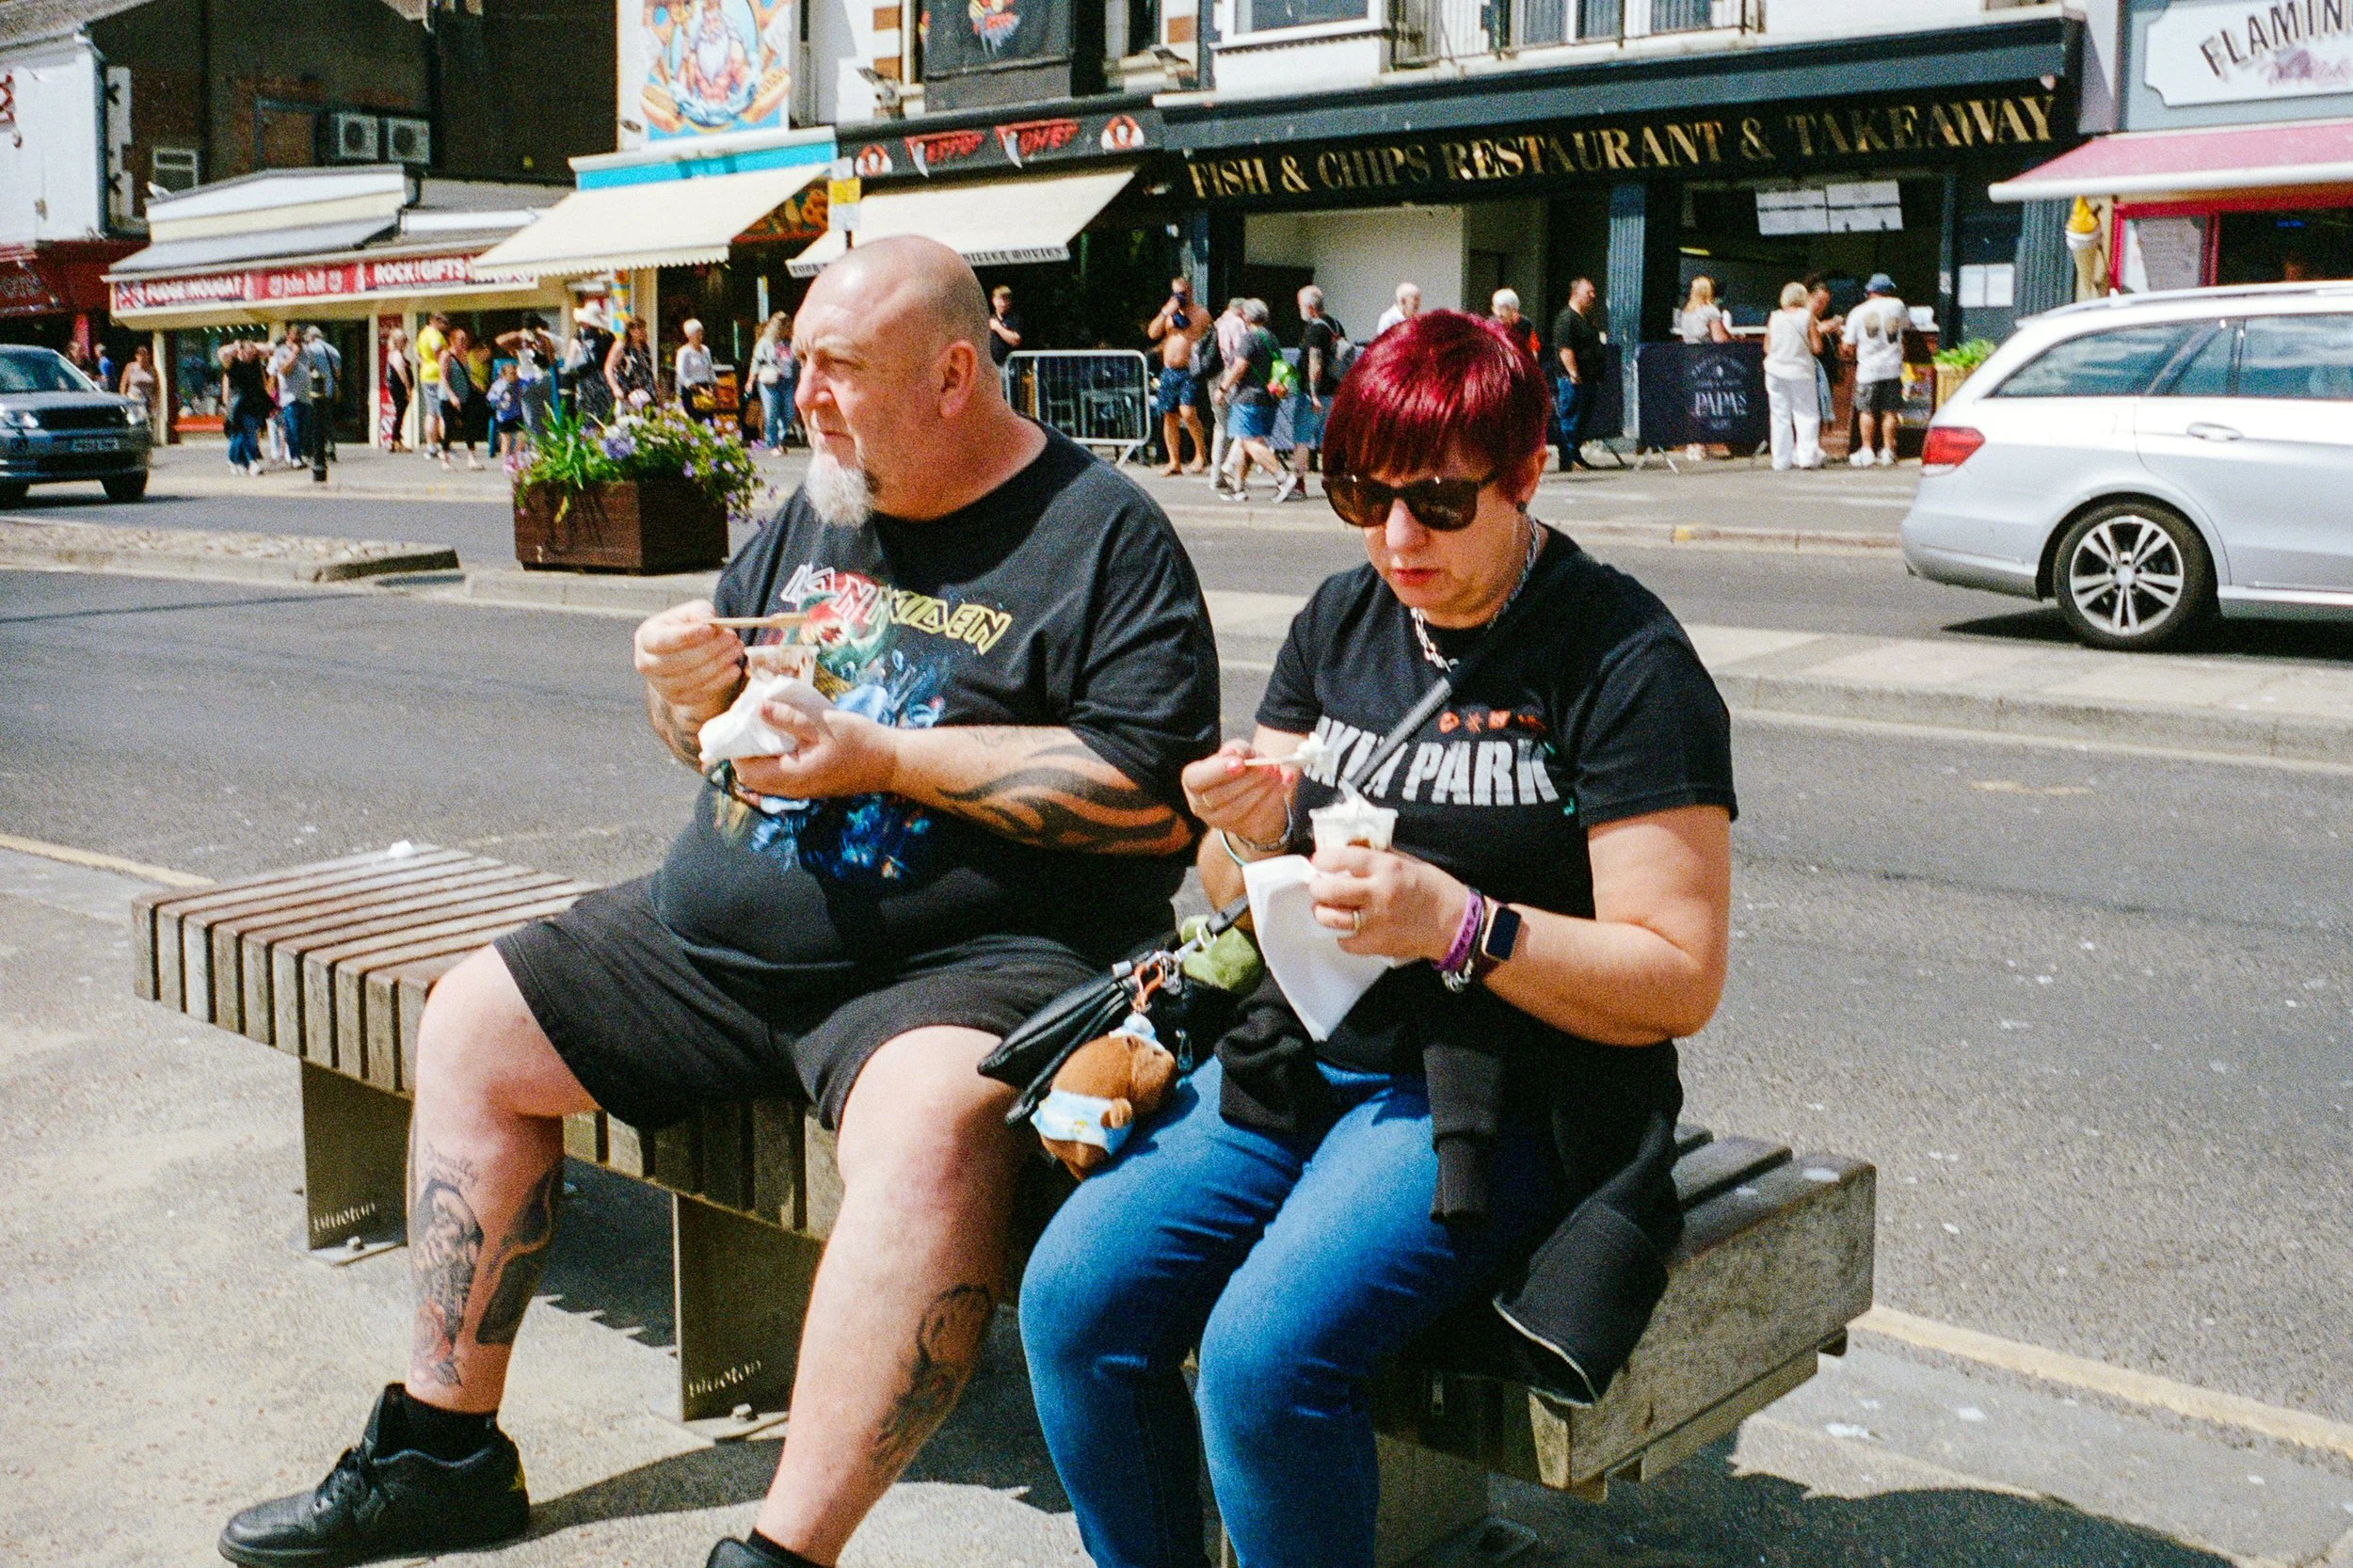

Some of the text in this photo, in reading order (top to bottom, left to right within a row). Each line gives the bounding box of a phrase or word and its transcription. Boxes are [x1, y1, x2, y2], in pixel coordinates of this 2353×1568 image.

[2200, 0, 2353, 77] FLAMIN
[1188, 96, 2054, 199] FISH & CHIPS RESTAURANT & TAKEAWAY
[1401, 739, 1561, 807] PARK
